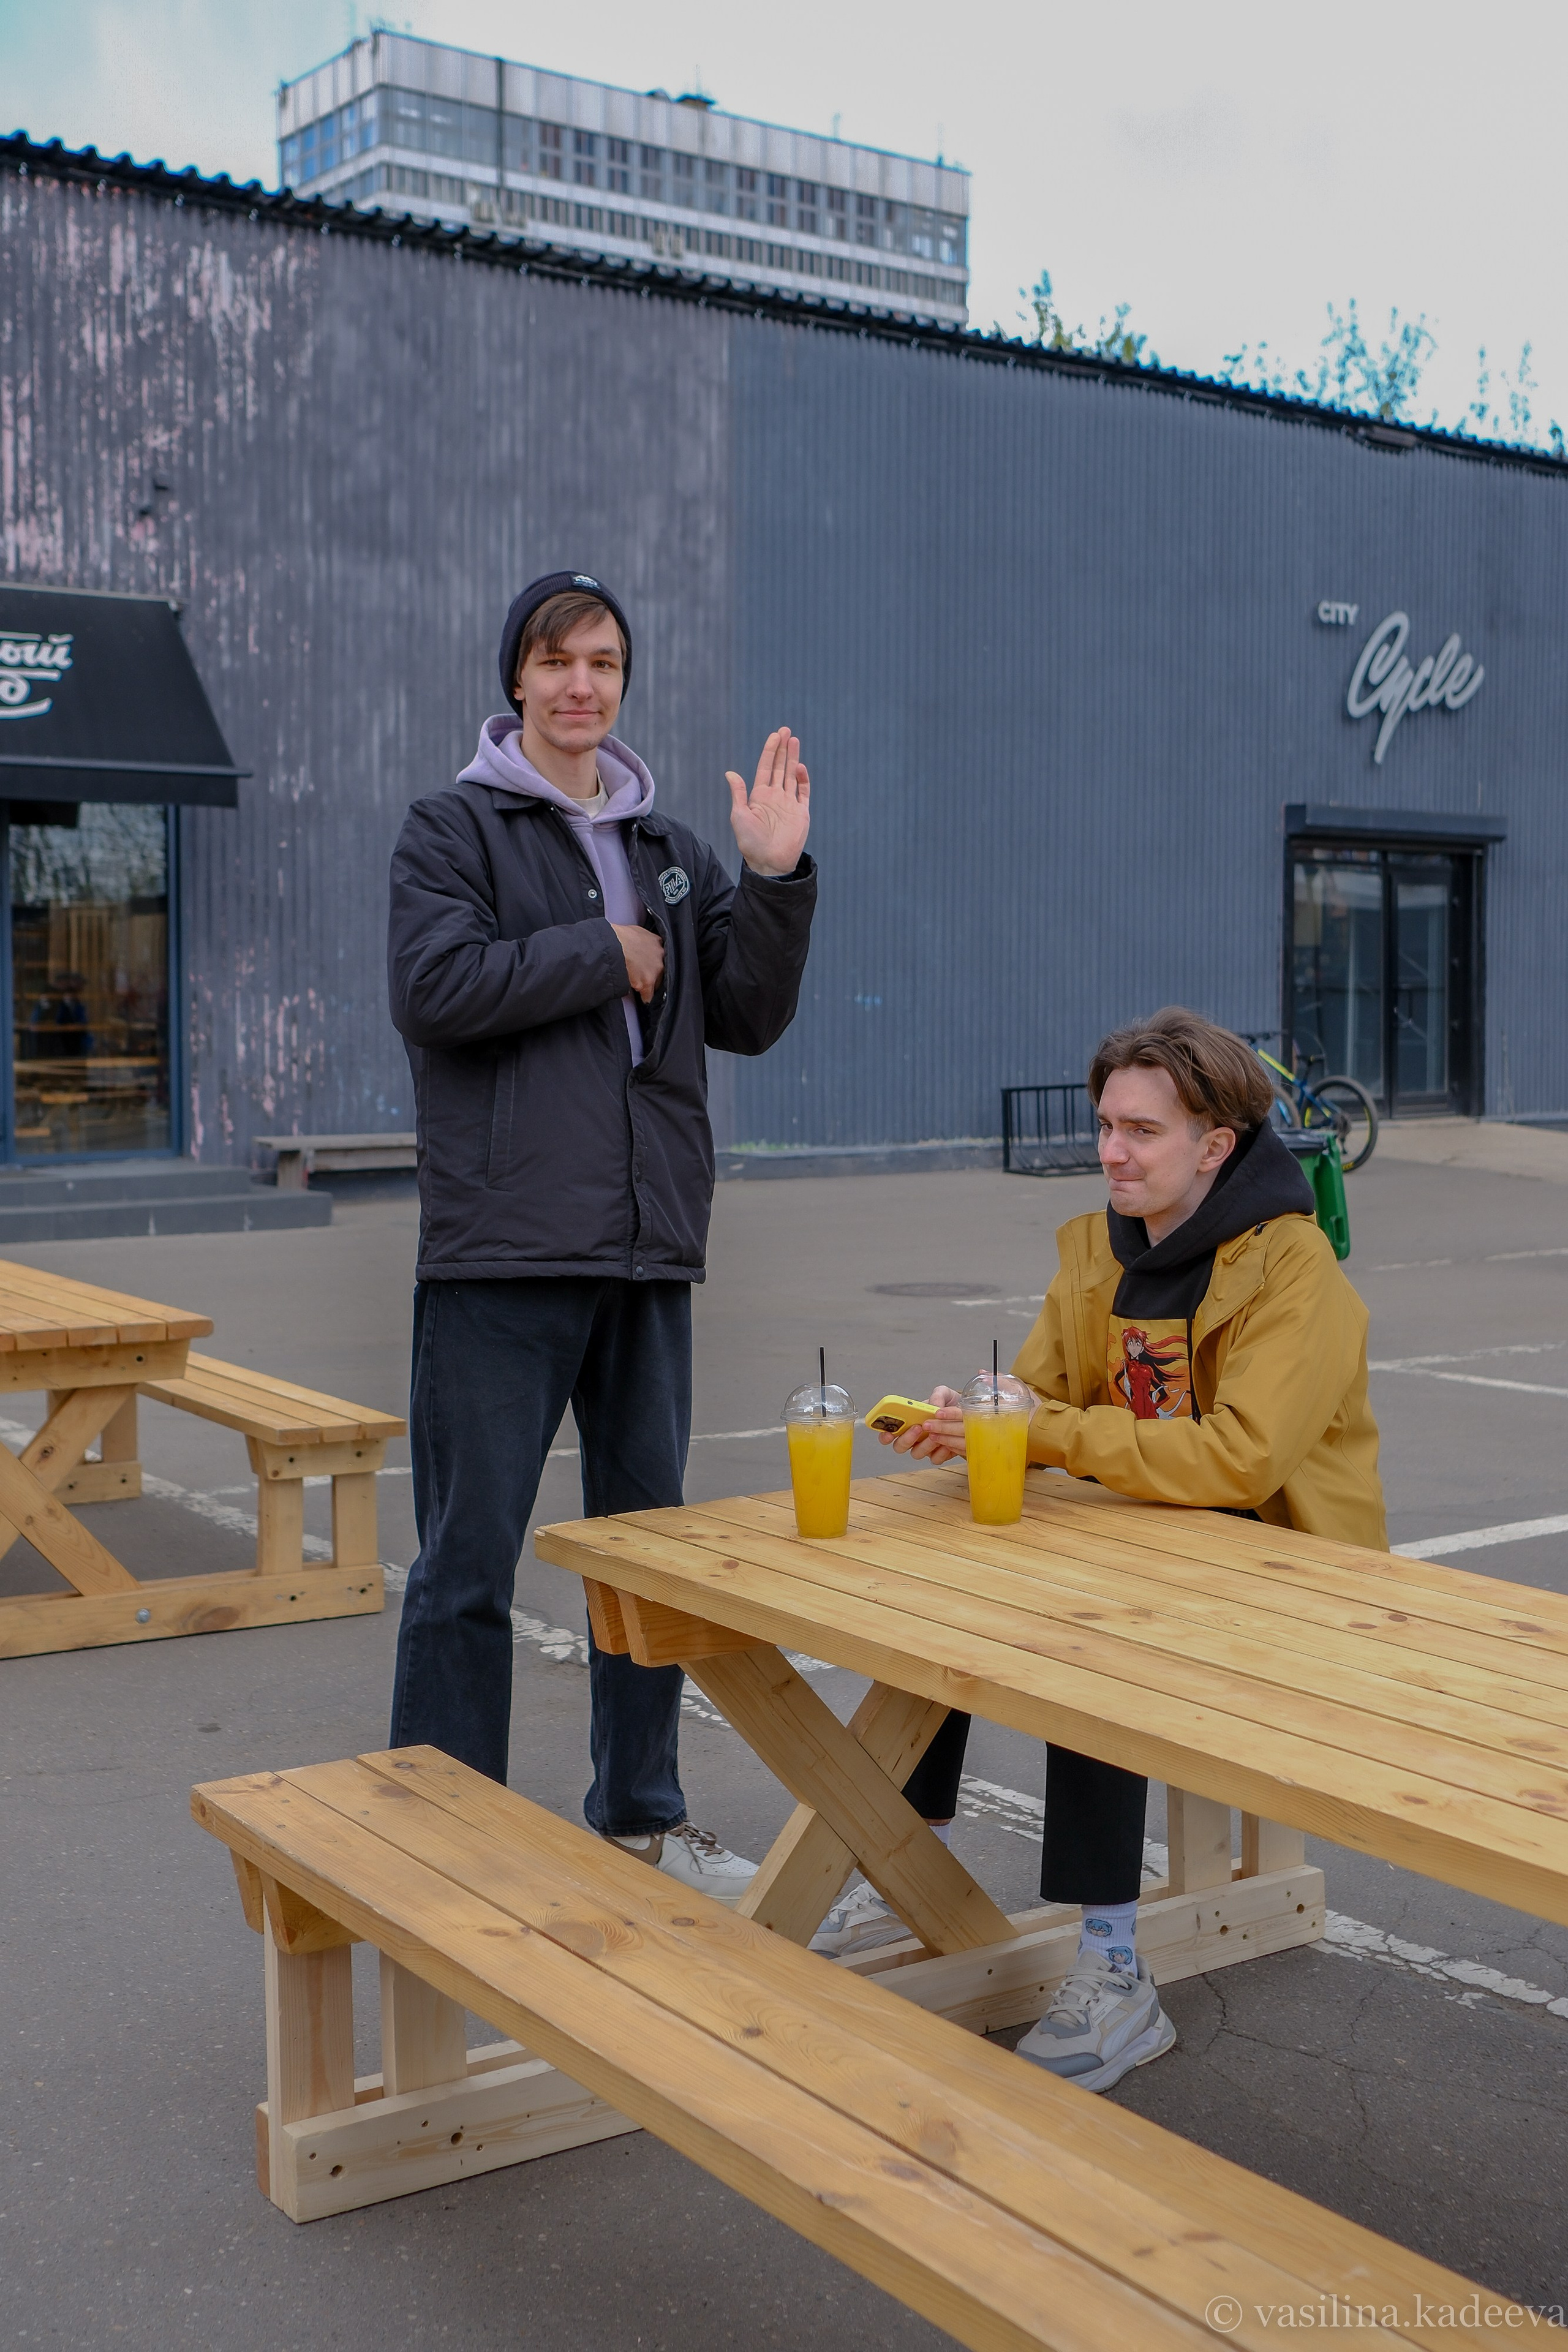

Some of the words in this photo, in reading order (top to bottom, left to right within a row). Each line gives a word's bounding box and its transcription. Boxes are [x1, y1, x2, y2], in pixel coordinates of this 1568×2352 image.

[1318, 600, 1359, 624] CITY
[1348, 611, 1484, 764] Cycle
[663, 874, 684, 897] FILA
